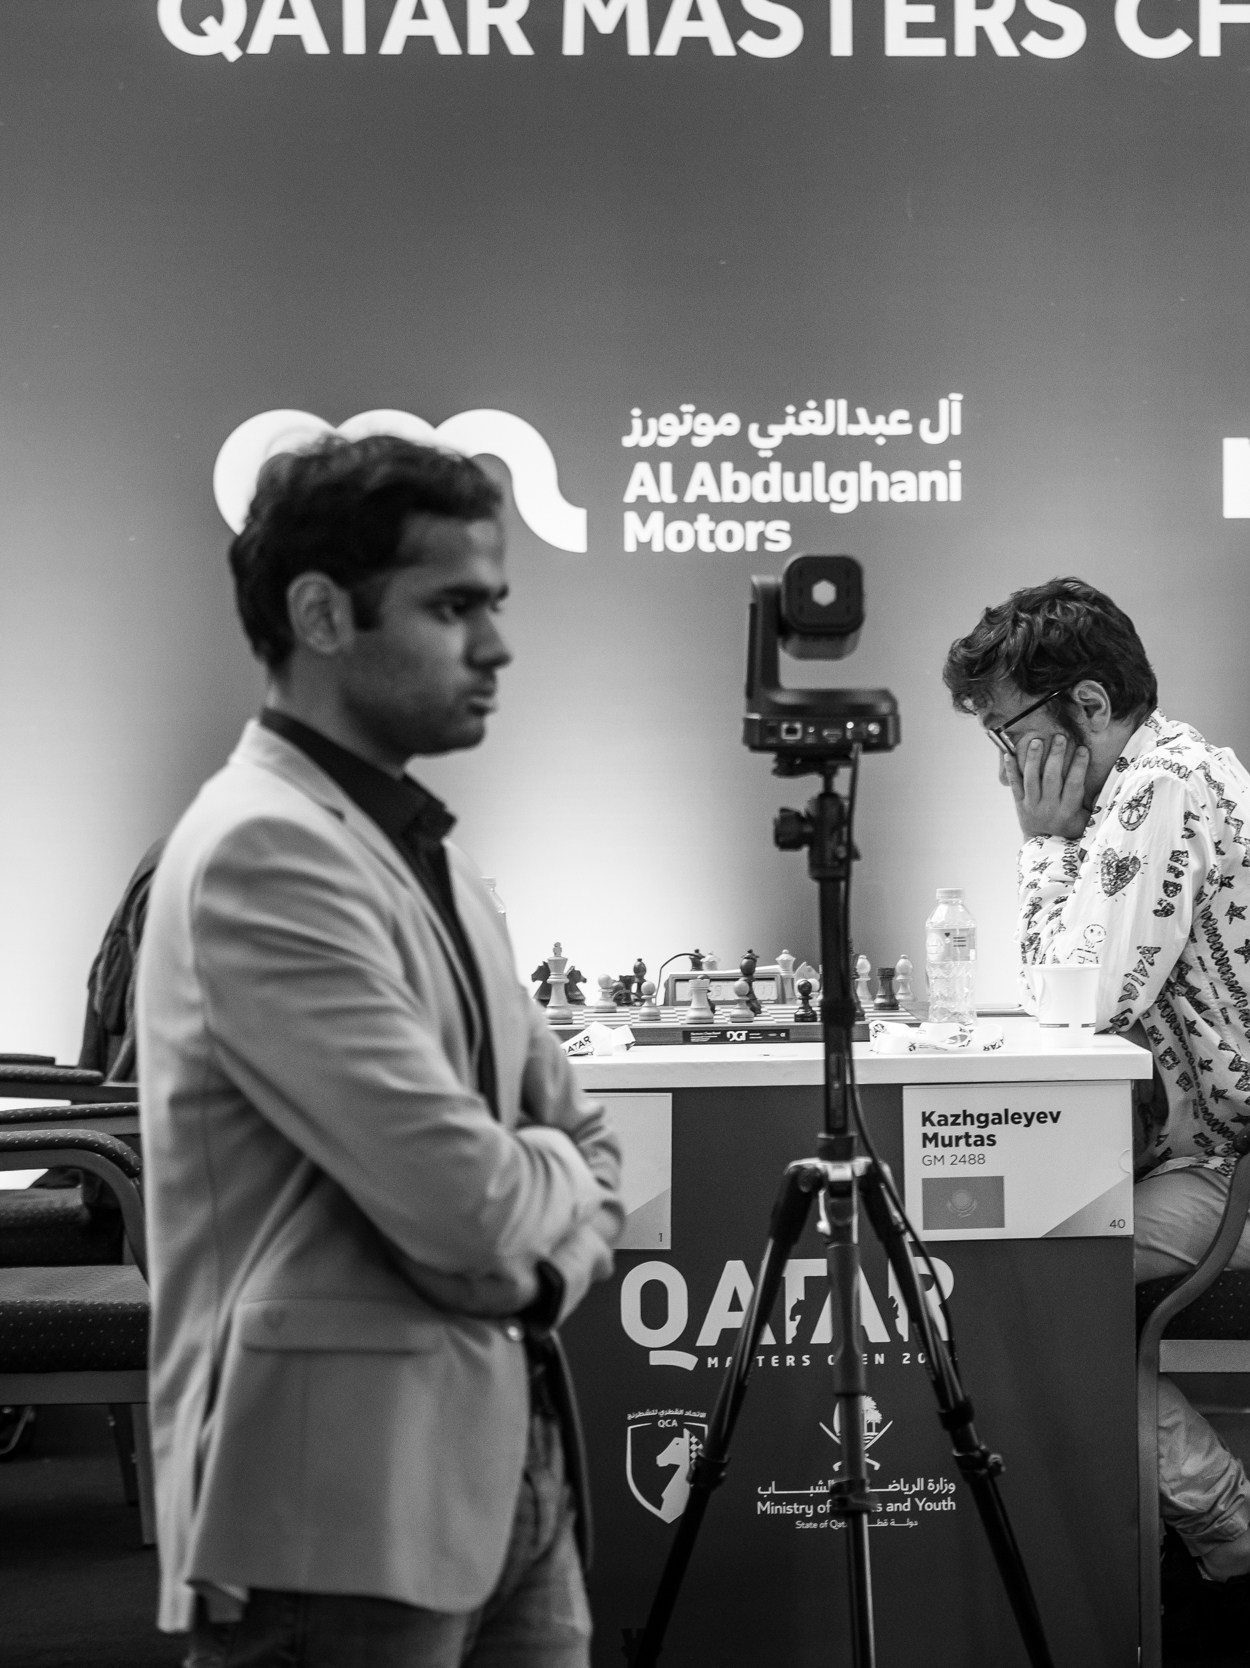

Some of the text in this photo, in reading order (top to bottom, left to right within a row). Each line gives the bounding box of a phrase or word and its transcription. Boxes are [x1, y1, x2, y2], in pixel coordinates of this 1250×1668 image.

[157, 0, 535, 63] QATAR
[562, 0, 1087, 60] MASTERS
[621, 392, 964, 458] آل عبدالغني موتورز
[622, 455, 962, 517] Al Abdulghani
[623, 510, 792, 553] Motors
[921, 1108, 1062, 1130] Kazhgaleyev
[921, 1131, 997, 1149] Murtas
[921, 1153, 986, 1167] GM 2488
[1109, 1219, 1126, 1229] 40
[707, 1355, 811, 1368] MATERS
[657, 1419, 678, 1428] QCA
[756, 1501, 813, 1517] Ministry
[817, 1499, 833, 1513] of
[886, 1497, 911, 1512] and
[914, 1496, 956, 1511] Youth
[795, 1520, 818, 1529] State
[819, 1519, 829, 1529] of
